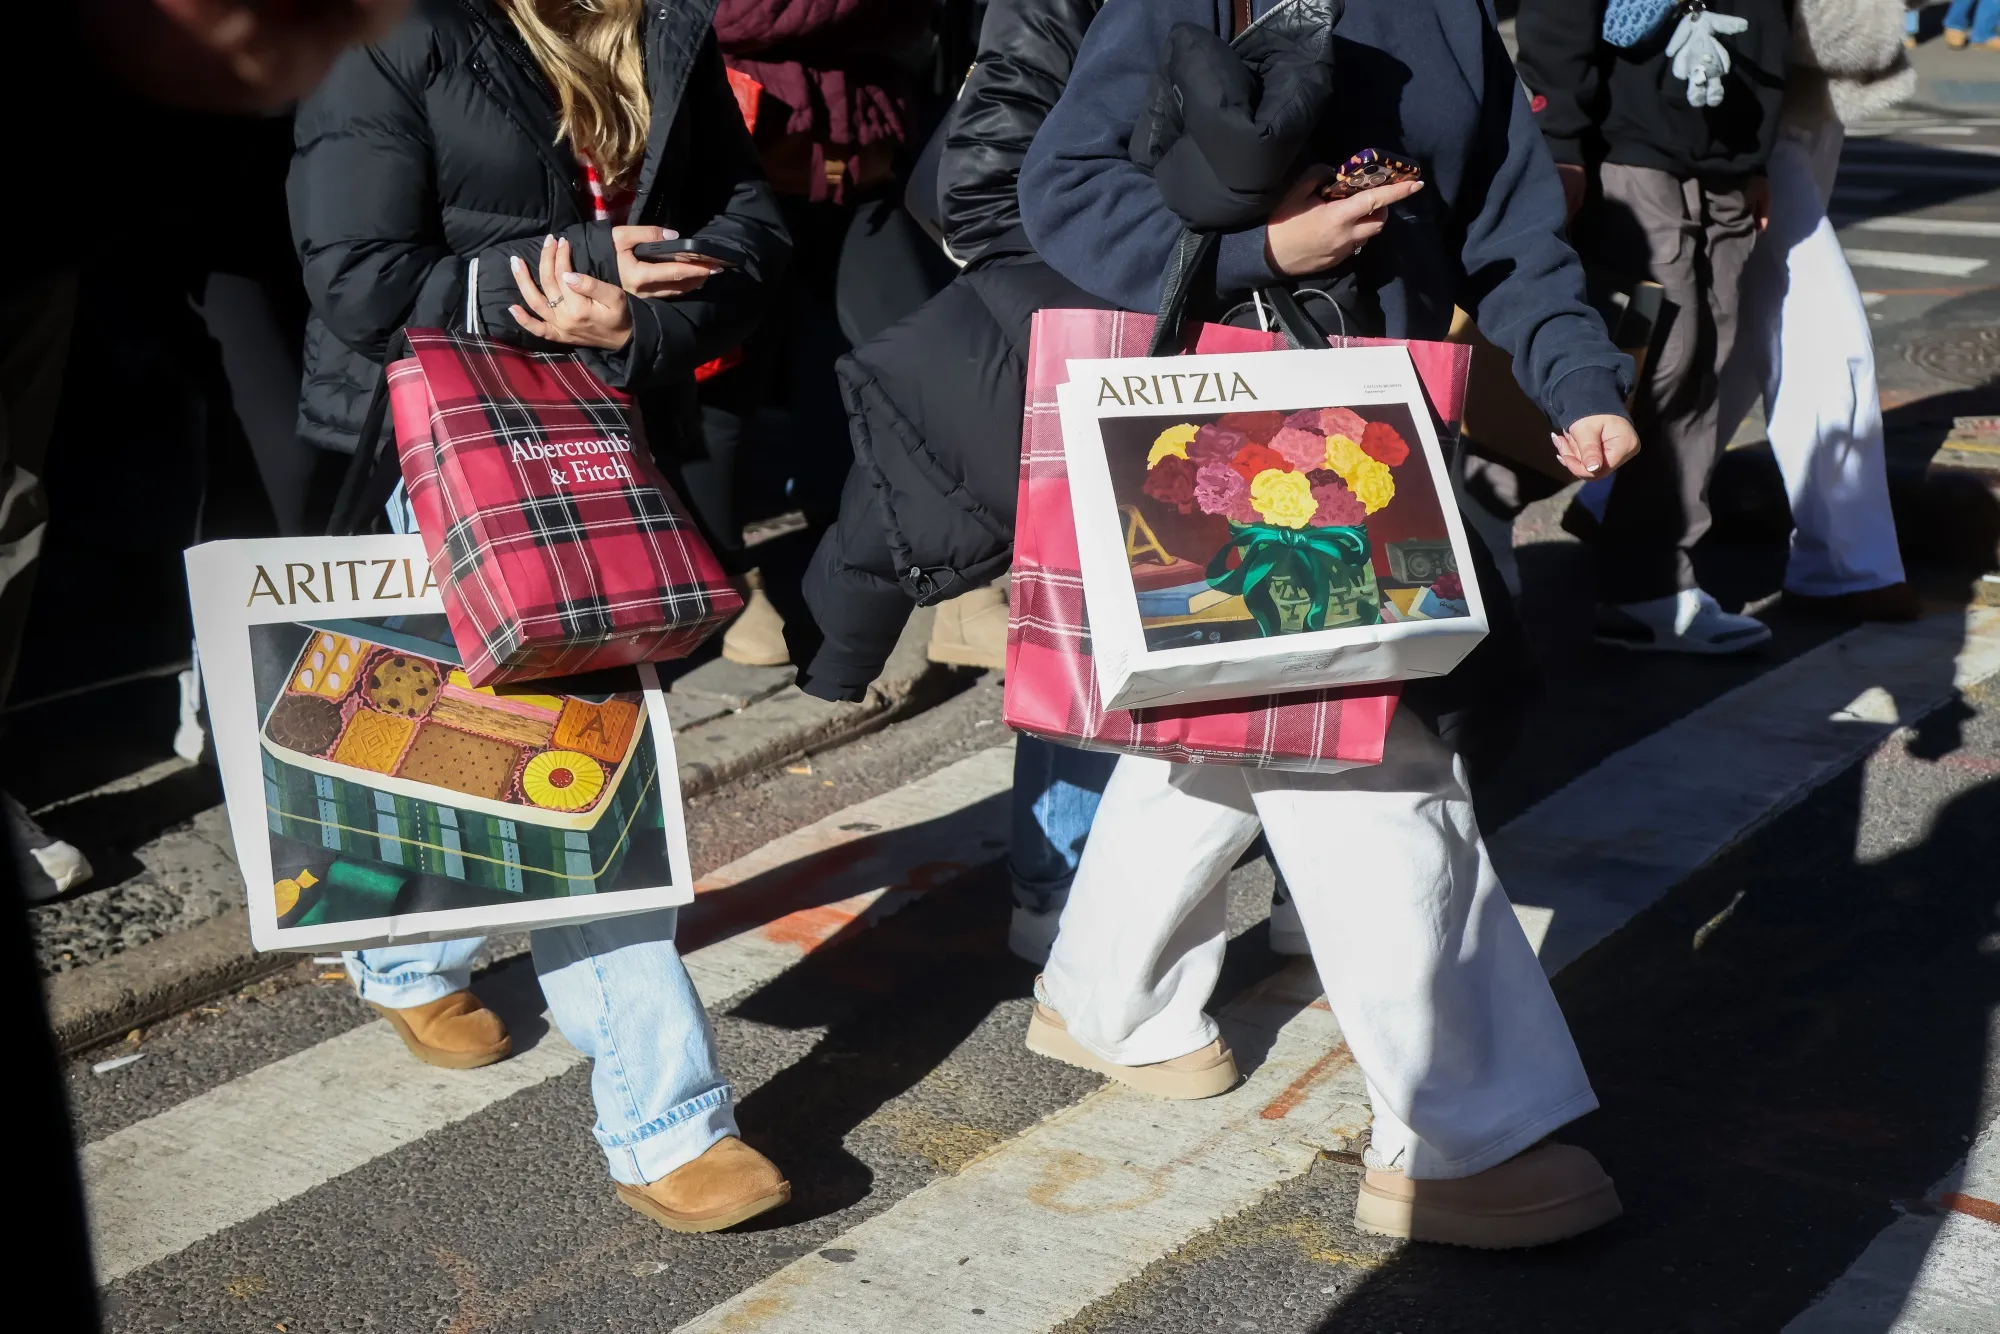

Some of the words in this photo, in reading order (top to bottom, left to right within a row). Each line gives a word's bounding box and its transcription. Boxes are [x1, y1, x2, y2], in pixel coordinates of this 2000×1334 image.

[1097, 371, 1258, 406] ARITZIA
[550, 468, 570, 486] &
[569, 456, 632, 483] Fitch
